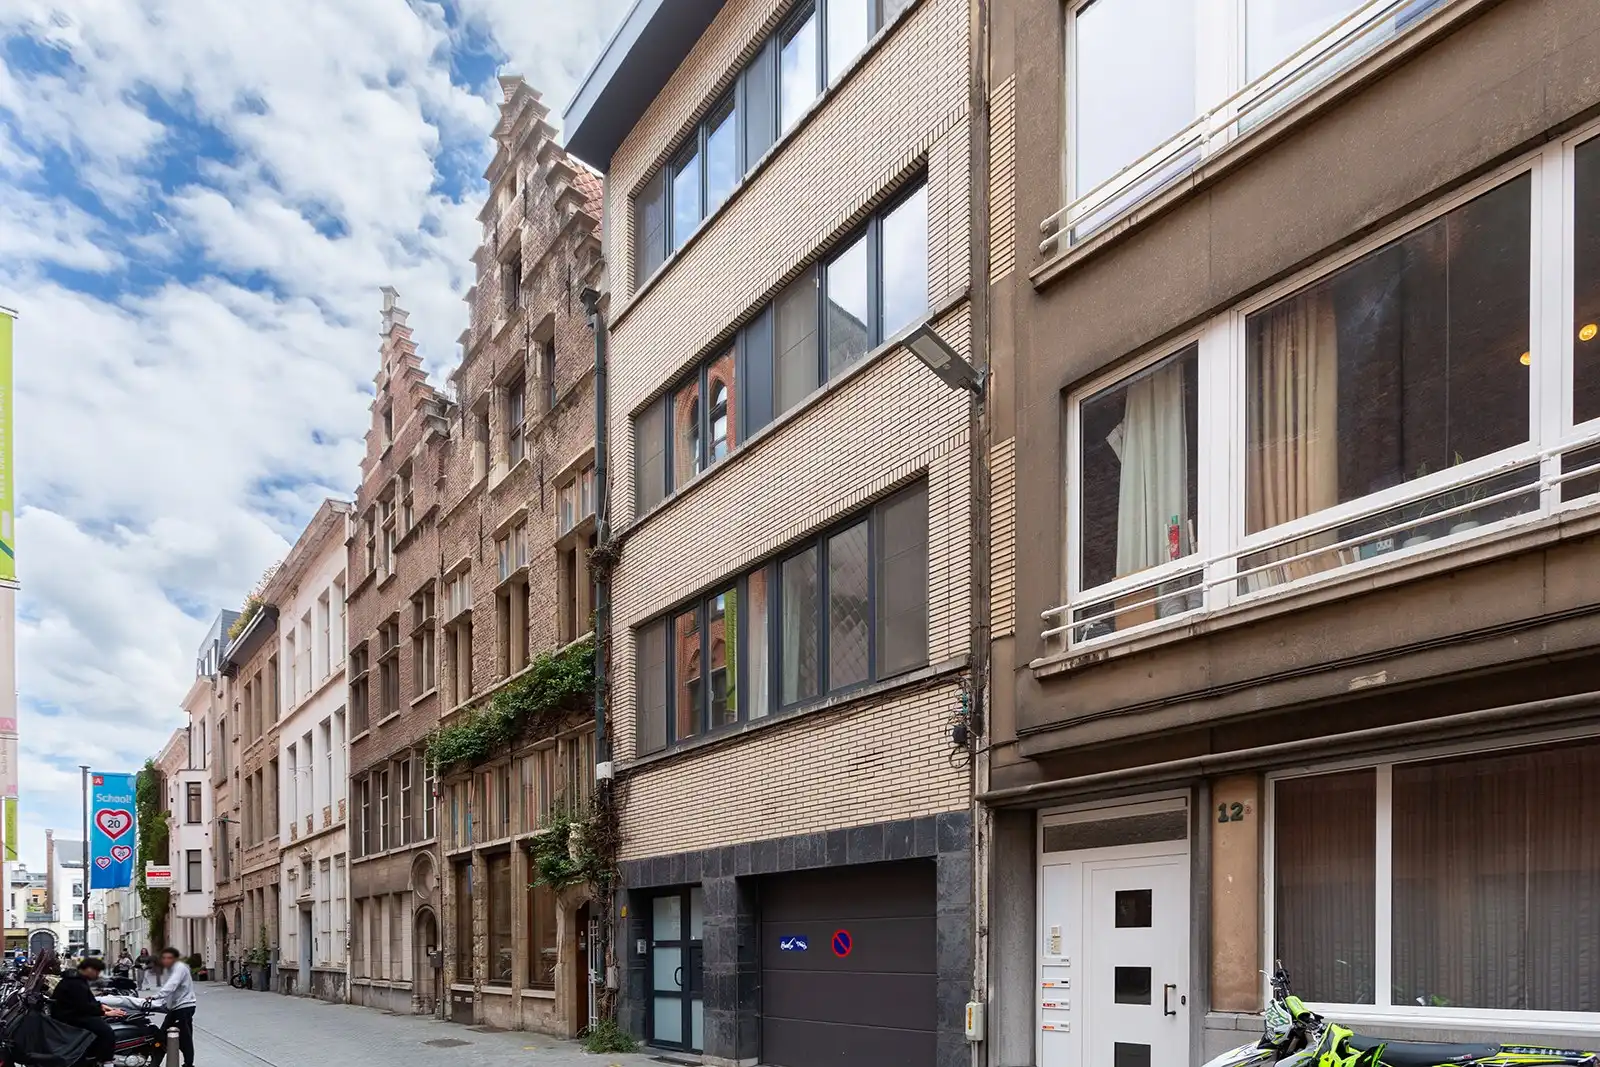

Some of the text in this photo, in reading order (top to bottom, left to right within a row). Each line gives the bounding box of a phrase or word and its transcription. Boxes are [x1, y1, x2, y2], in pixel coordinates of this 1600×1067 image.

[96, 793, 132, 804] School!
[1218, 802, 1244, 823] 12
[107, 819, 121, 829] 20
